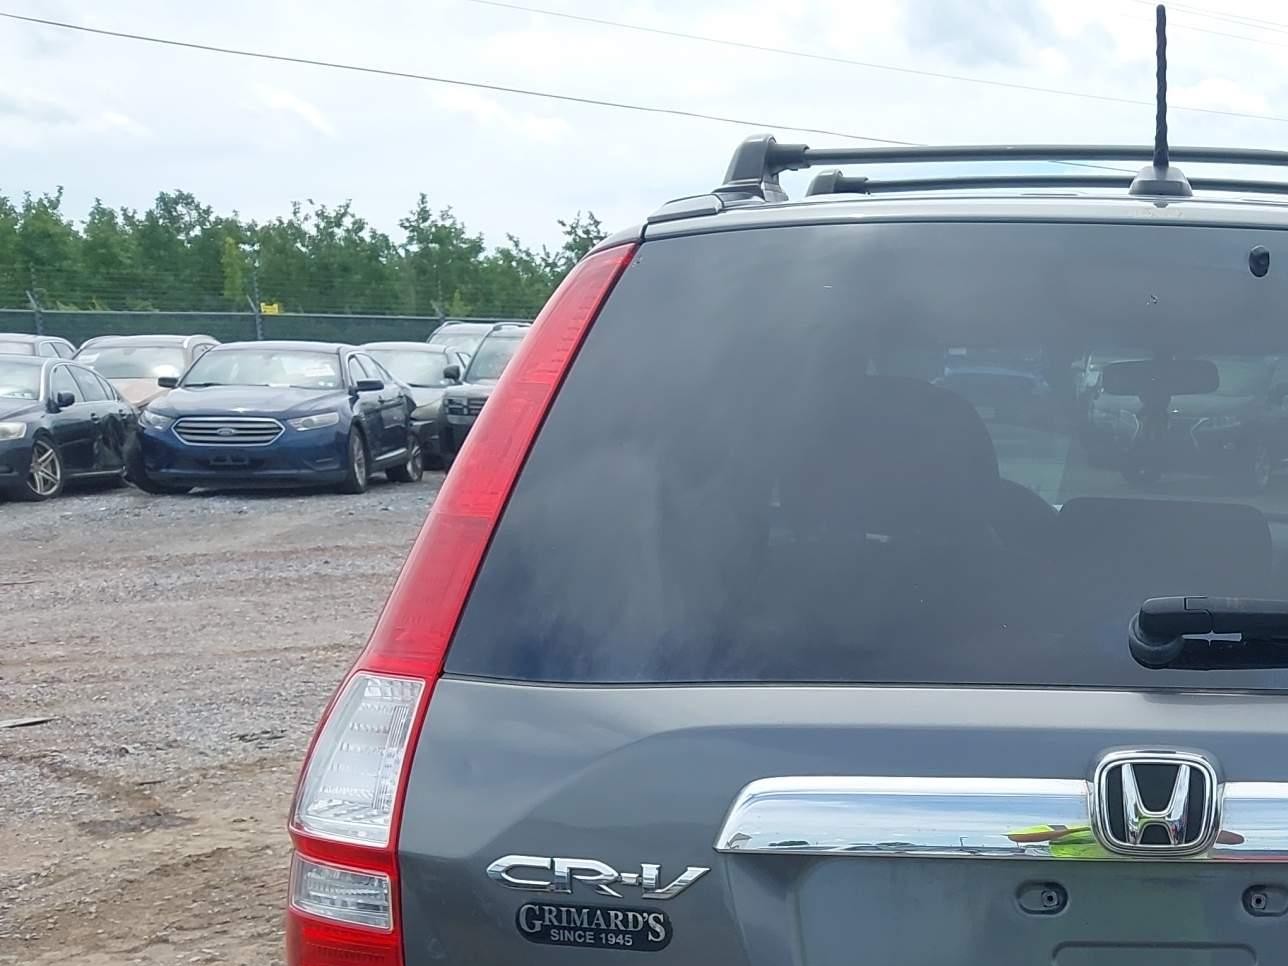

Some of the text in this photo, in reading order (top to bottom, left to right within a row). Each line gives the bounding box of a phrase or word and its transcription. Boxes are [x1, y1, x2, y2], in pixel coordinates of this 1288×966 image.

[486, 854, 711, 900] CR-V
[518, 904, 666, 942] GRIMARD'S
[550, 929, 633, 946] SINCE 1945
